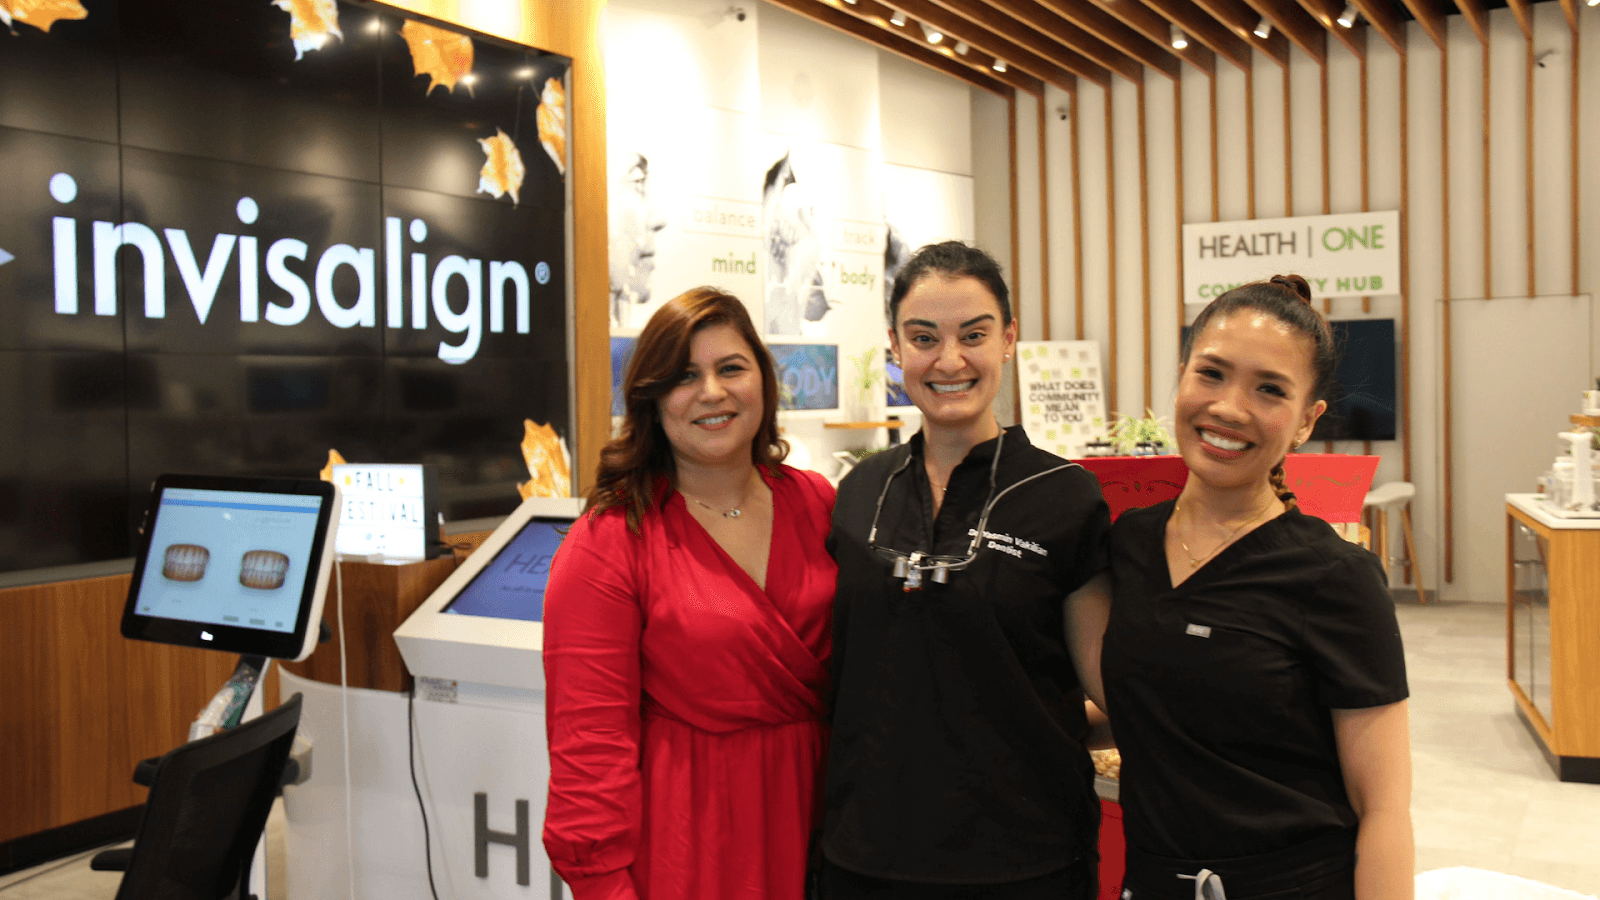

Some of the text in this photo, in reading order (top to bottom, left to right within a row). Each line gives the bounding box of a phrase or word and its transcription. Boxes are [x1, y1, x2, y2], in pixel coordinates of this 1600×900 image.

[694, 205, 757, 229] balance
[843, 228, 876, 246] track
[1199, 225, 1384, 259] HEALTH ONE
[711, 251, 757, 275] mind
[840, 264, 876, 291] body
[1337, 275, 1383, 292] HUB
[782, 364, 836, 396] ODY
[1029, 380, 1096, 391] WHAT DOES
[1029, 391, 1099, 402] COMMUNITY
[1045, 402, 1079, 412] MEAN
[1044, 413, 1084, 423] TO YOU
[356, 471, 394, 492] FALL
[347, 500, 418, 523] ESTIVAL
[987, 541, 1022, 558] Dentist
